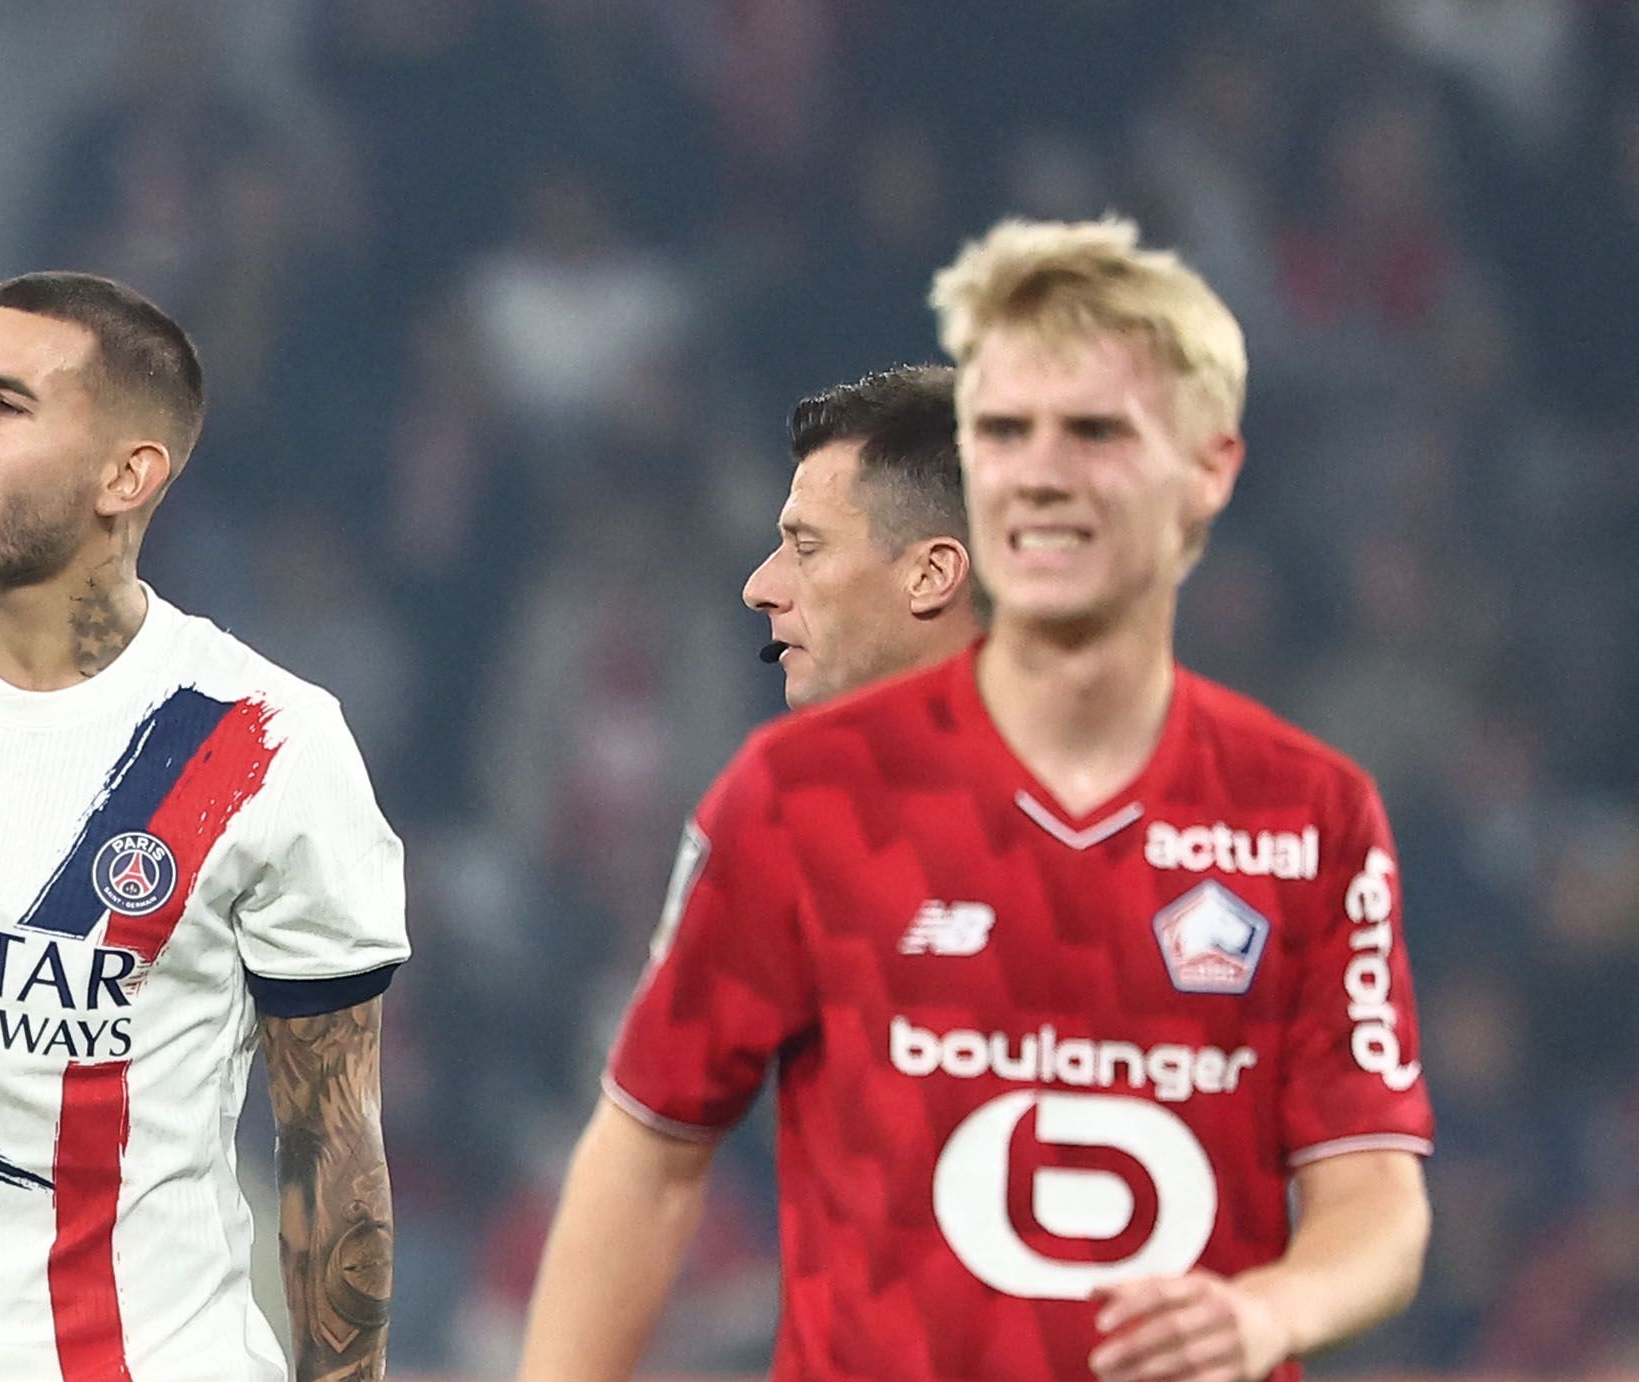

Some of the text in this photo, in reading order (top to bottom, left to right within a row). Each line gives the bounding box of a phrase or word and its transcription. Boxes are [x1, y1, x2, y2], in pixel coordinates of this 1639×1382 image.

[112, 837, 165, 861] PARIS
[1143, 820, 1321, 880] actual
[890, 1013, 1258, 1102] boulanger
